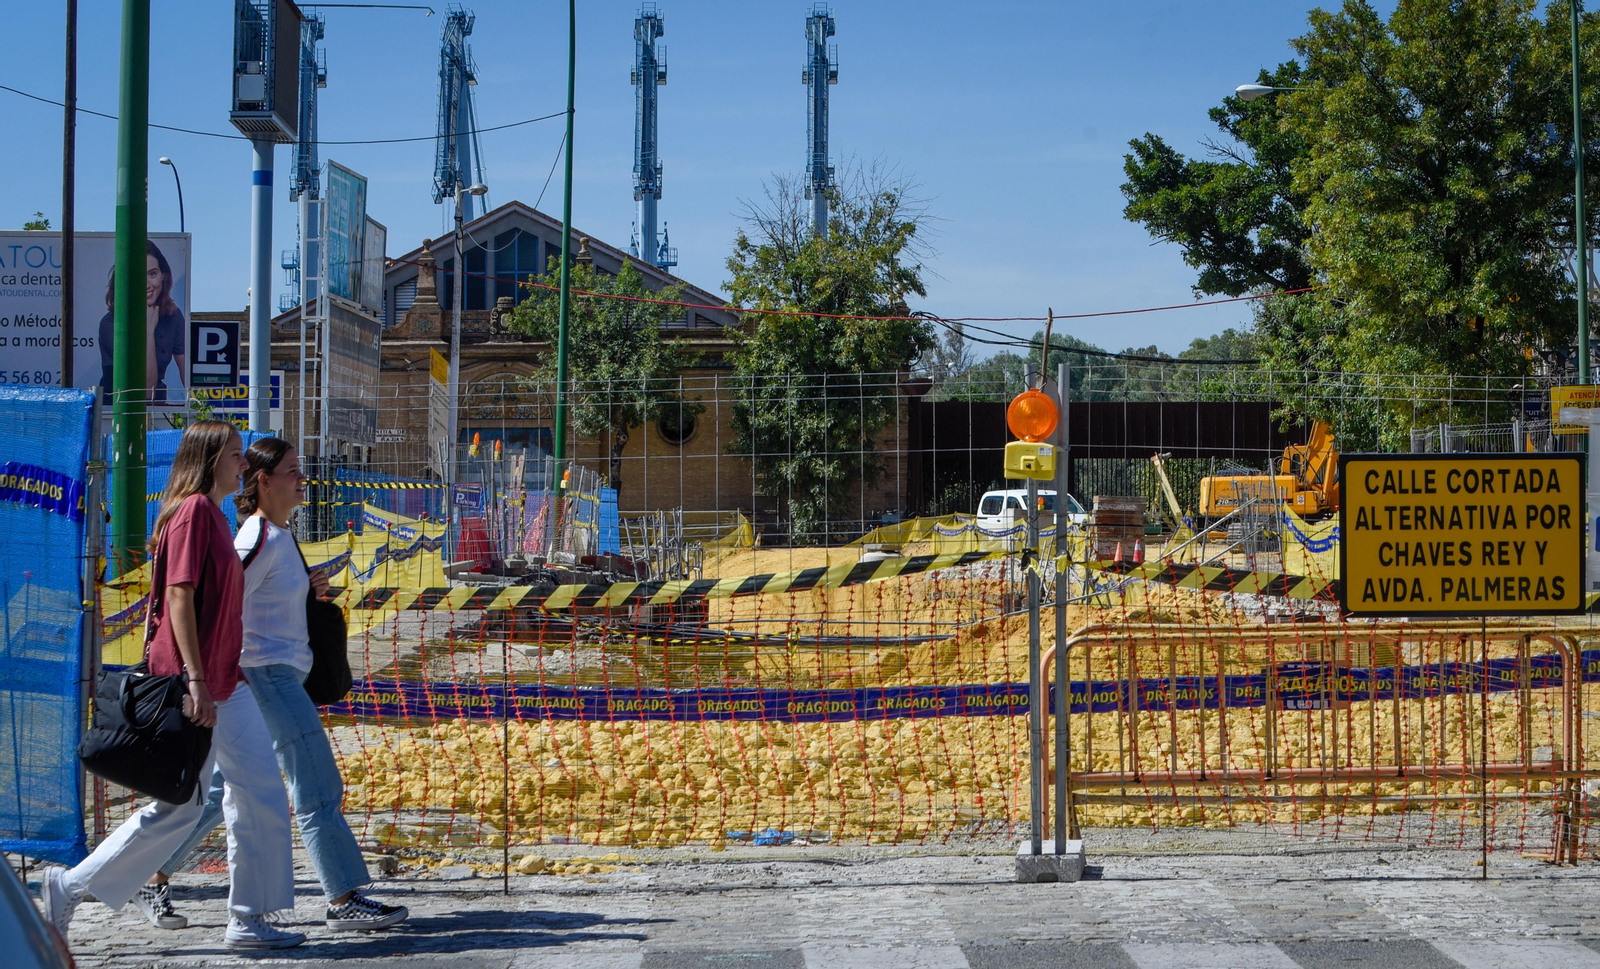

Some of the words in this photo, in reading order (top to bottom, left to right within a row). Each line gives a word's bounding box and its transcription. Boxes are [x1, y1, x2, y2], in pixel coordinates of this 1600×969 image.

[20, 271, 62, 286] denta
[11, 335, 20, 347] a
[25, 333, 94, 347] mordcos
[197, 326, 229, 363] P
[12, 370, 30, 384] 56
[33, 370, 52, 384] 80
[0, 474, 64, 501] DRAGADOS
[1364, 469, 1437, 495] CALLE
[1446, 468, 1561, 494] CORTADA
[1355, 505, 1517, 531] ALTERNATIVA
[1526, 504, 1571, 530] POR
[1378, 541, 1472, 567] CHAVES
[1482, 541, 1526, 566] REY
[1535, 540, 1548, 565] Y
[1362, 577, 1432, 602] AVDA.
[1441, 575, 1565, 602] PALMERAS
[517, 696, 586, 710] DRAGADOS
[607, 698, 676, 712] DRAGADOS
[697, 699, 766, 712] DRAGADOS
[787, 700, 856, 713] DRAGADOS
[877, 696, 946, 710] DRAGADOS
[966, 693, 1029, 707] DRAGADO
